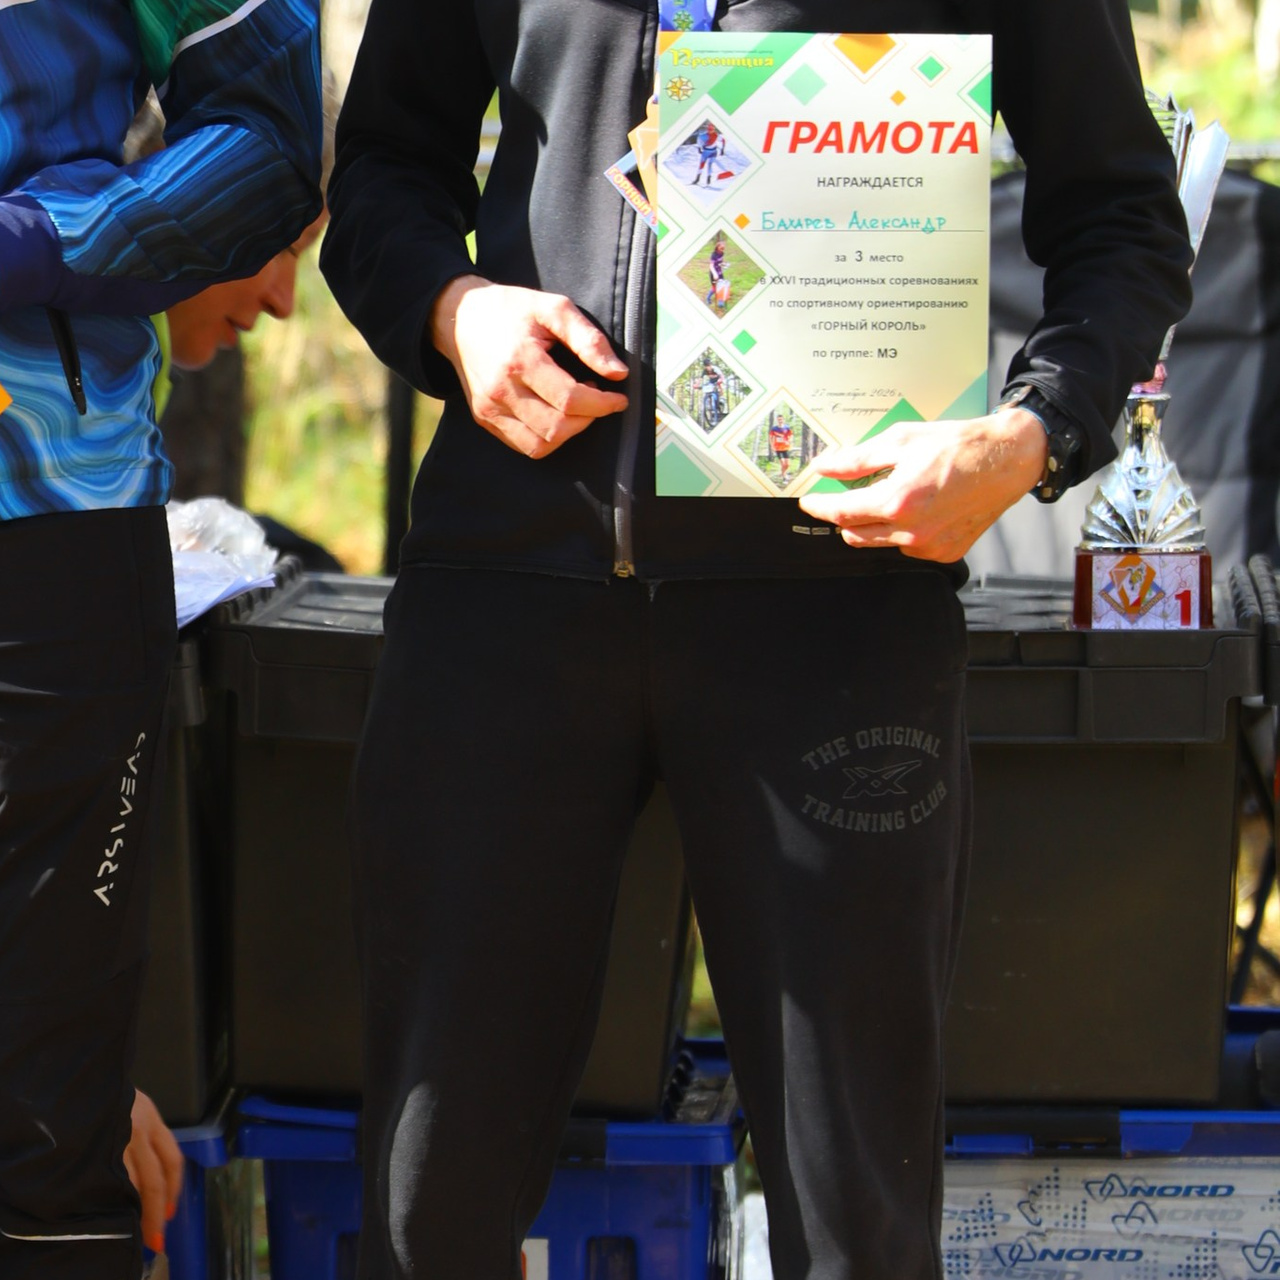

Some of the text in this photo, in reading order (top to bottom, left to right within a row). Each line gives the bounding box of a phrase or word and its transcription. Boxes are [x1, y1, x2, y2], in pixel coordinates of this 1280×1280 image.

[762, 121, 980, 154] ГРАМОТА
[817, 177, 924, 189] НАГРАЖДАЕТСЯ
[834, 251, 904, 263] за 3 место
[760, 276, 979, 290] в XXVI традиционных соревнованиях
[770, 300, 968, 312] по спортивному ориентированию
[811, 319, 926, 331] «ГОРНЫЙ КОРОЛЬ»
[813, 348, 898, 360] по группе: МЭ
[1175, 589, 1191, 626] 1
[801, 726, 941, 771] THE ORIGINAL
[801, 780, 947, 833] TRAINING CLUB
[1128, 1184, 1236, 1198] NORD
[1037, 1248, 1144, 1263] NORD
